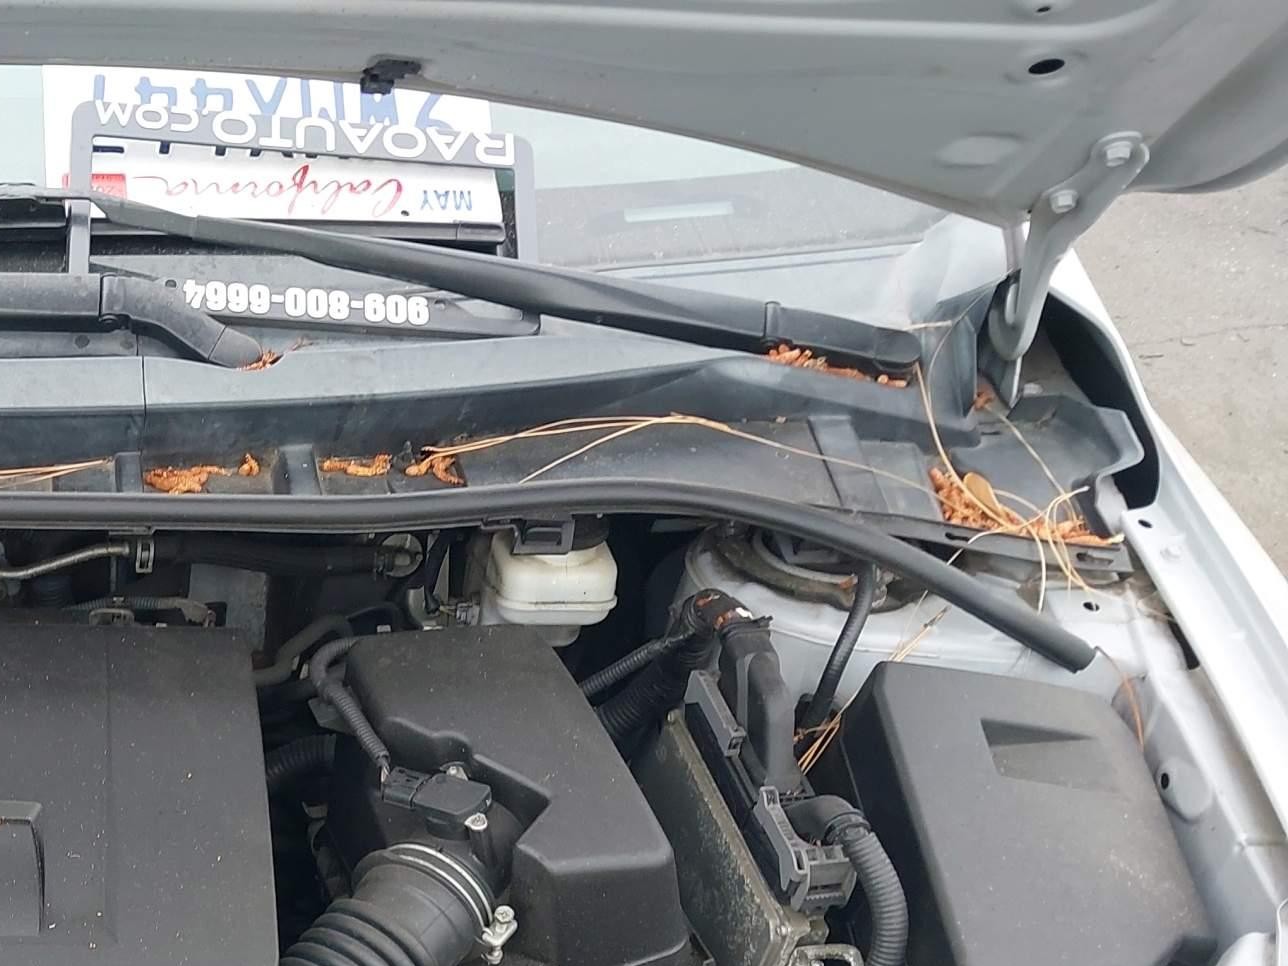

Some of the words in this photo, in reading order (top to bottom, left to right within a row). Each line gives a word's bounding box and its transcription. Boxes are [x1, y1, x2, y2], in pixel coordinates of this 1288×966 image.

[132, 163, 404, 217] California
[420, 188, 474, 211] MAY
[183, 279, 430, 326] 909-800-6664
